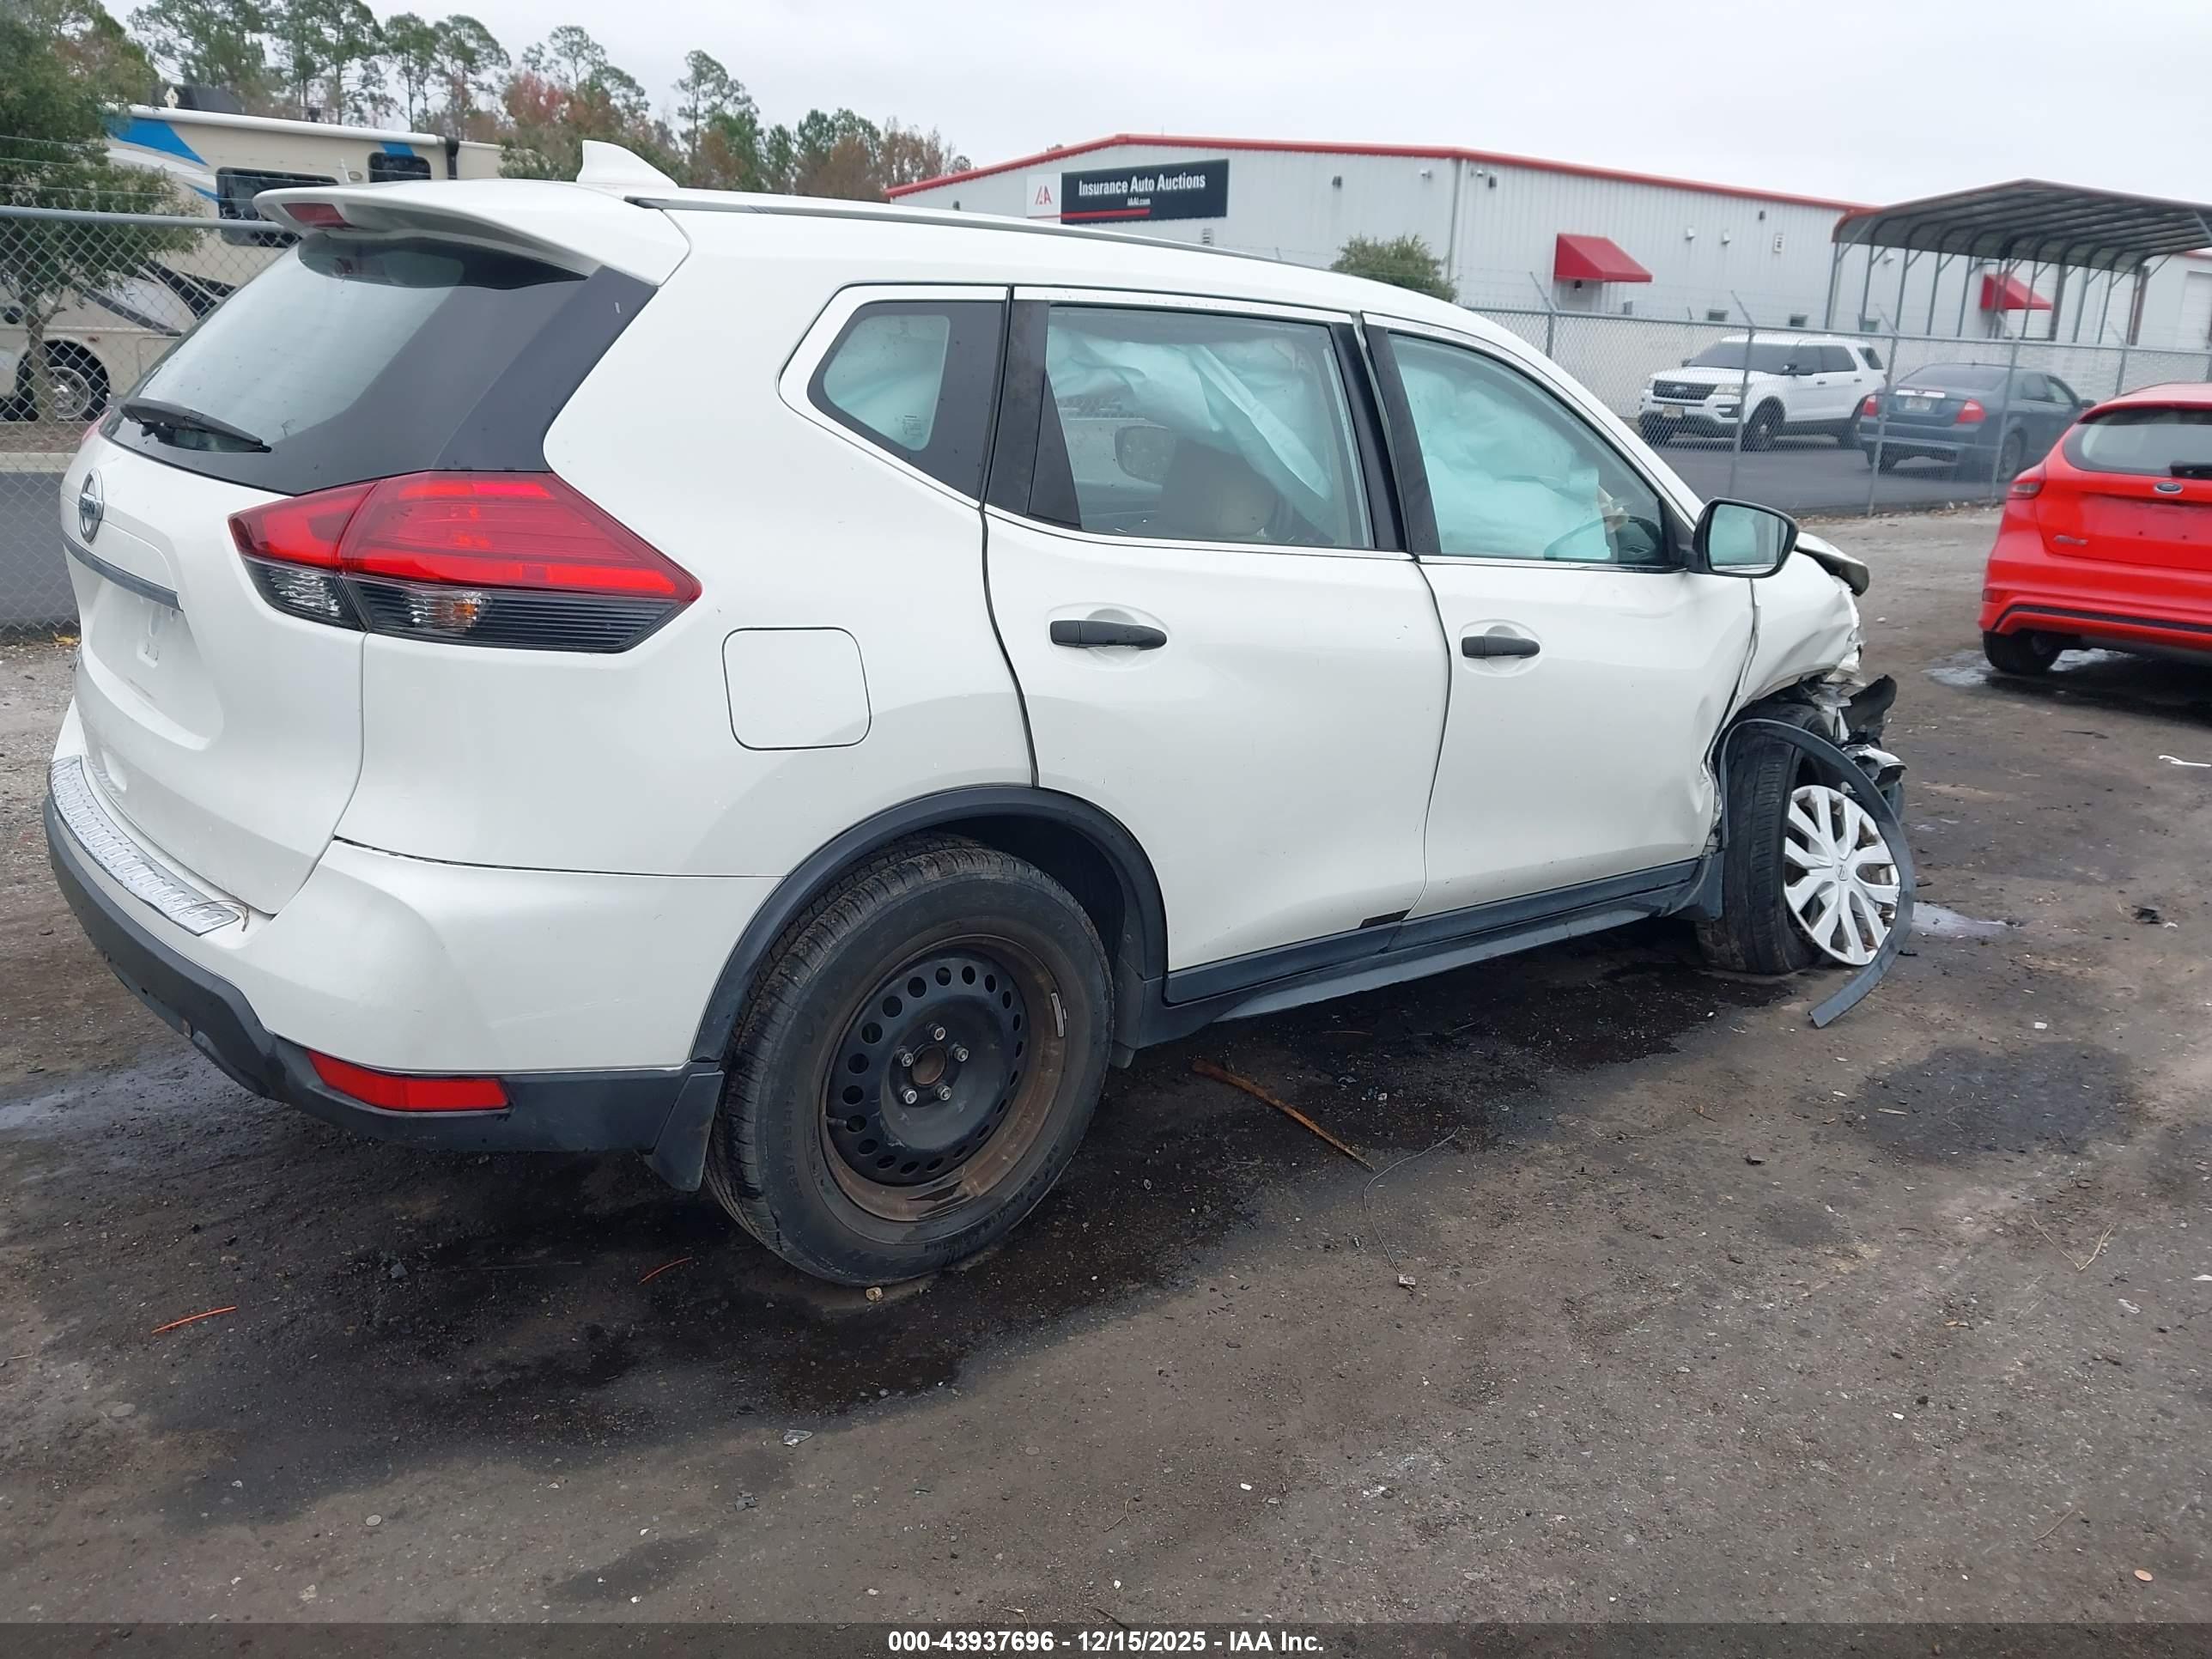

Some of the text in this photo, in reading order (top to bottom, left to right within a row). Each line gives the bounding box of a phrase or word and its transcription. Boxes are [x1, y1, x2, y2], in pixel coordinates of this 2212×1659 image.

[1079, 172, 1206, 197] Insurance Auto Auctions
